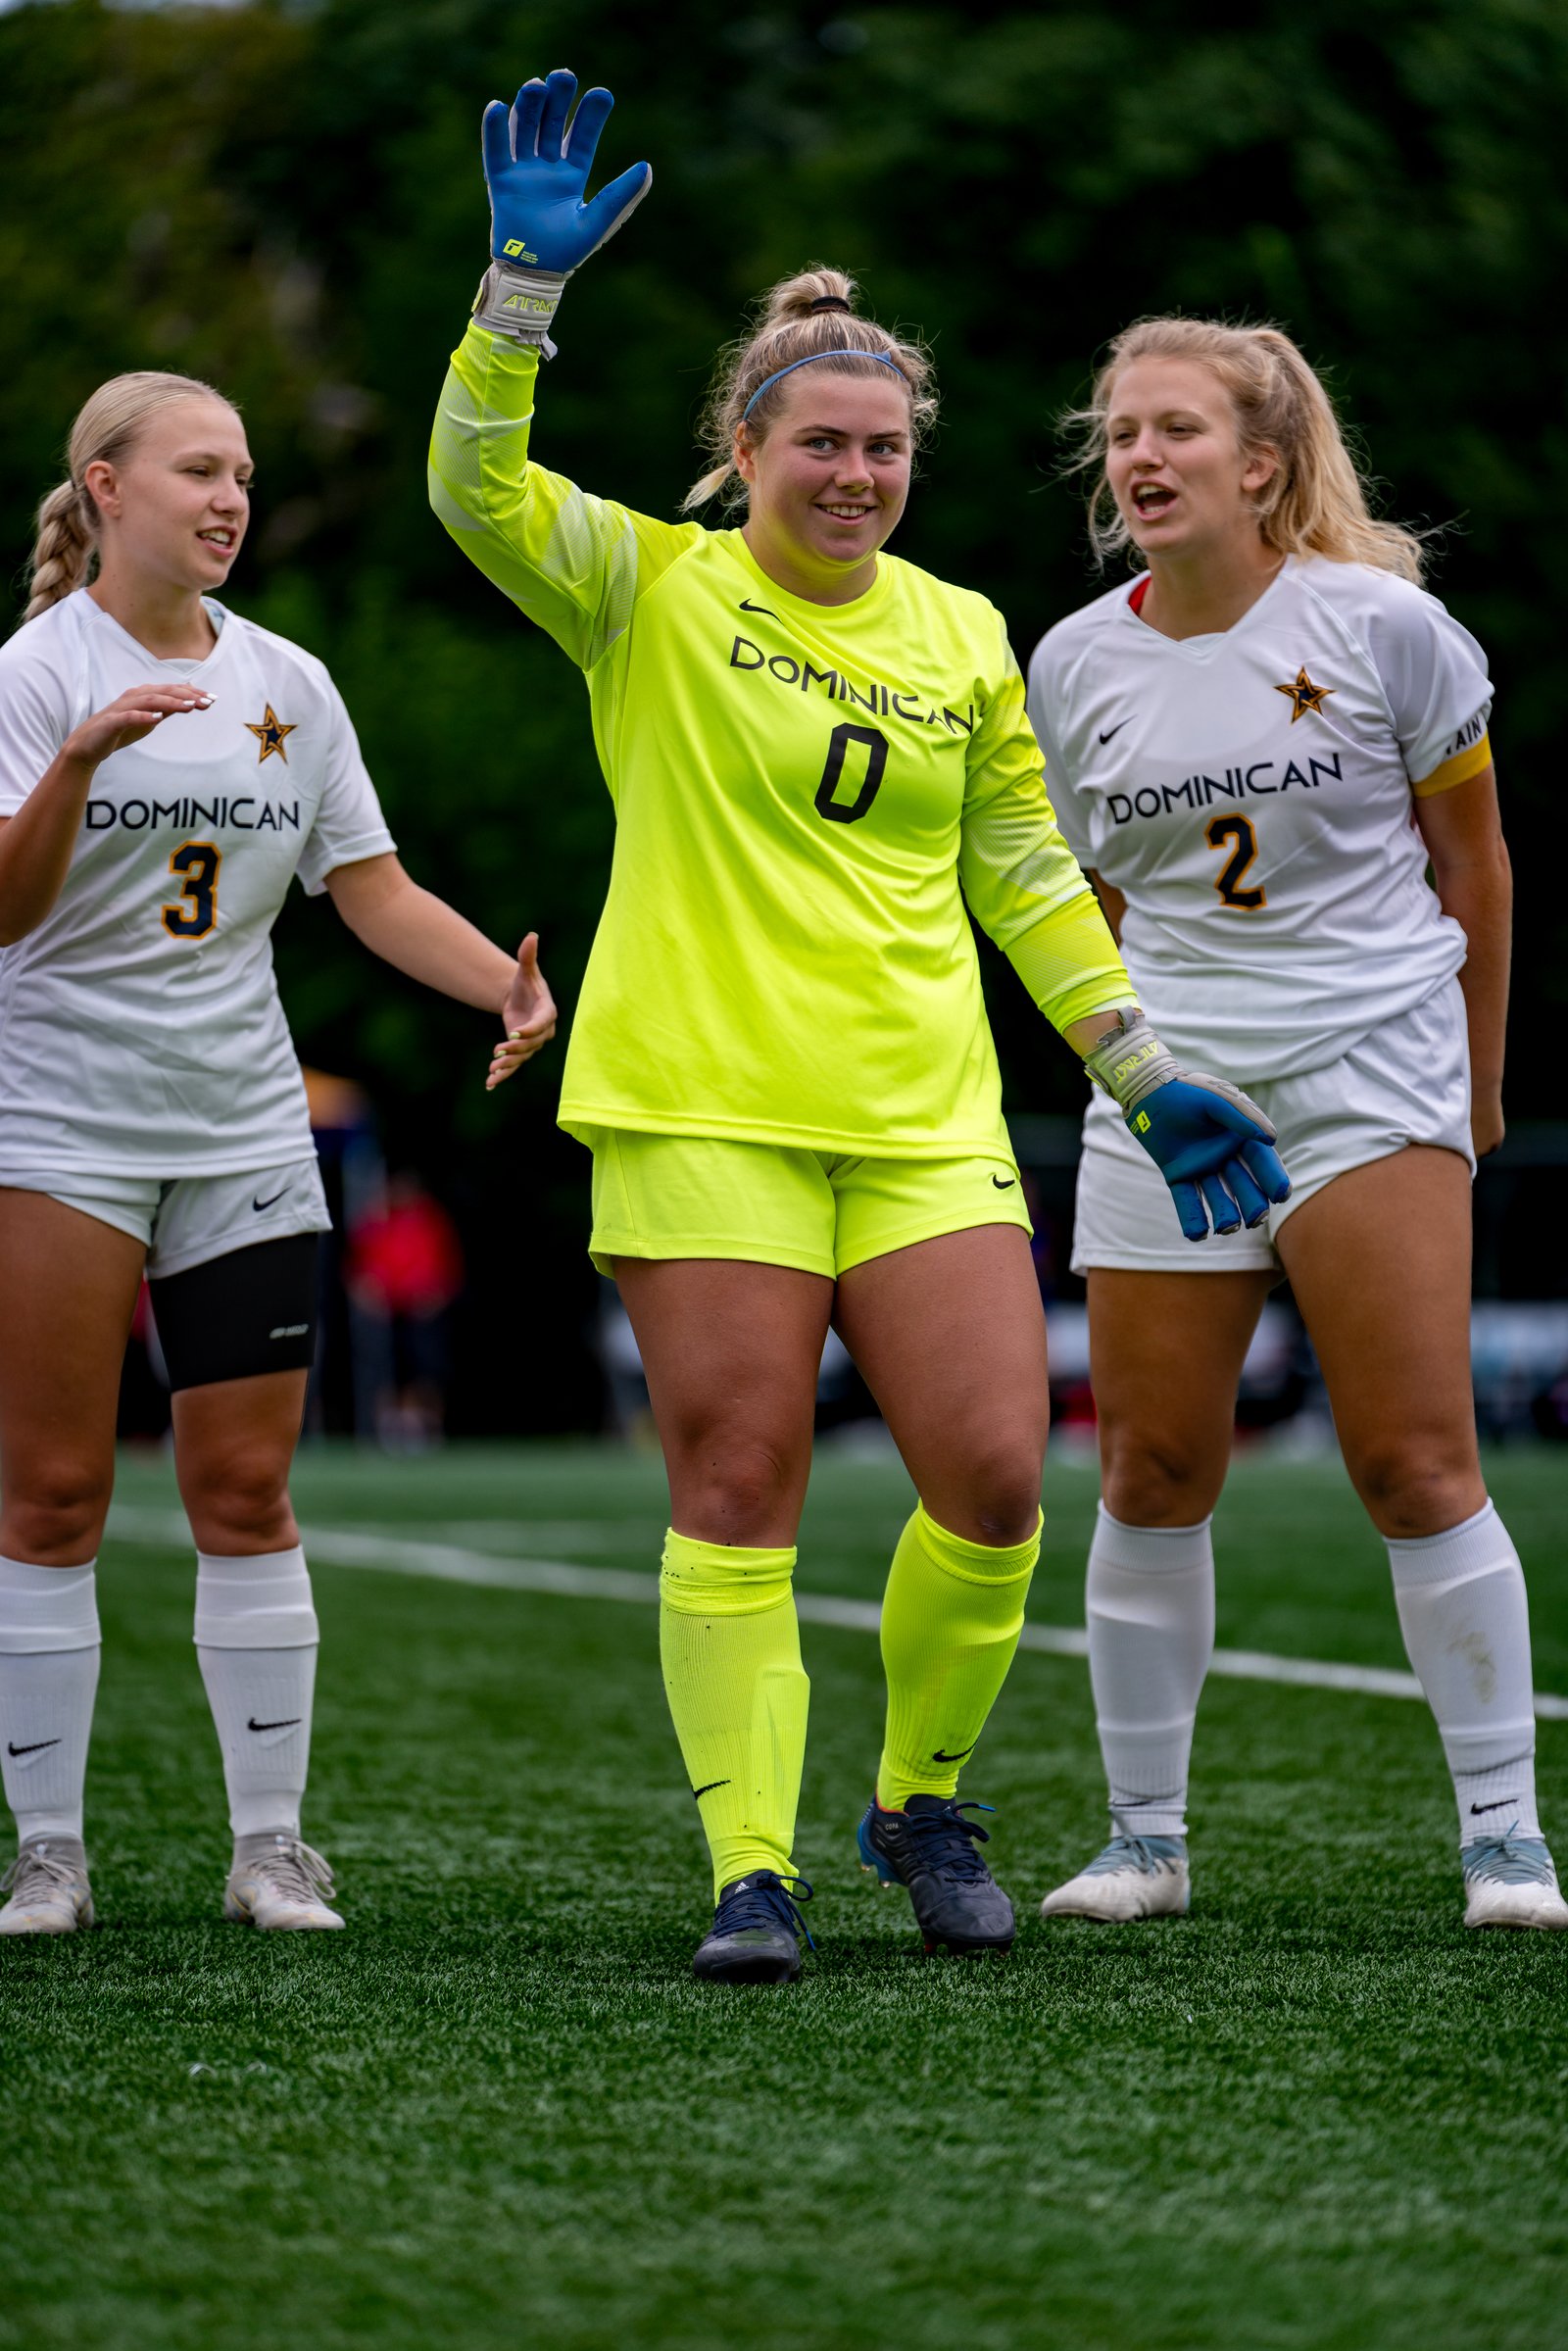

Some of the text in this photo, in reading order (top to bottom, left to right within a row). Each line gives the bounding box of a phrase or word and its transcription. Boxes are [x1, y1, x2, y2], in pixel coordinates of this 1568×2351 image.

[730, 635, 974, 736] DOMINICAN
[1446, 714, 1483, 756] AIN
[85, 797, 300, 831] DOMINICAN
[814, 722, 890, 824] 0
[1106, 753, 1344, 824] DOMINICAN
[161, 840, 222, 940] 3
[1203, 811, 1267, 911] 2
